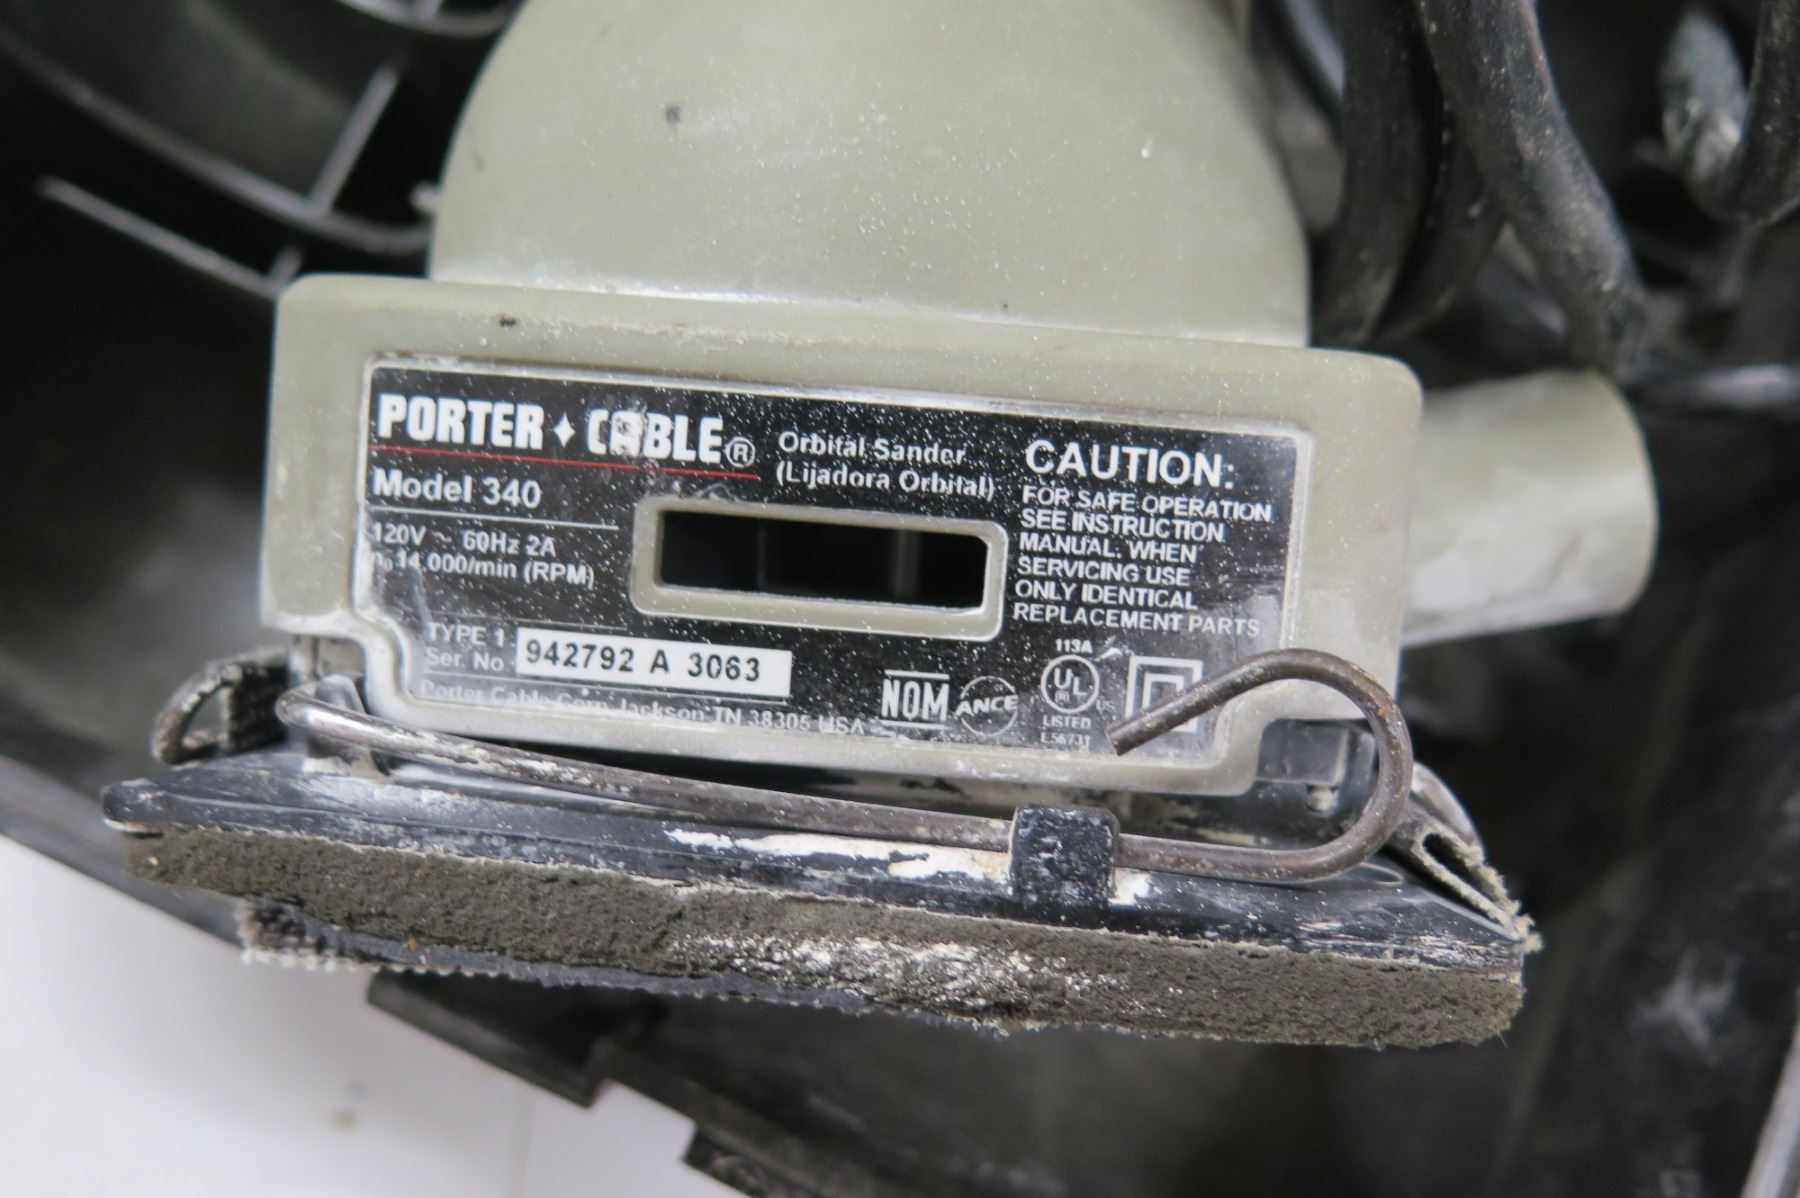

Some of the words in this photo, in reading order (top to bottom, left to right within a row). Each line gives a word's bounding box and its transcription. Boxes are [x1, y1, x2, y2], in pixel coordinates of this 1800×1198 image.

[375, 392, 545, 450] PORTER
[778, 431, 866, 458] Orbital
[873, 438, 966, 465] Sander
[1024, 438, 1235, 490] CAUTION:
[371, 467, 472, 501] Model
[482, 476, 542, 509] 340
[775, 460, 891, 490] (Lijadora
[899, 469, 995, 500] Orbital)
[1022, 484, 1070, 507] FOR
[1077, 490, 1136, 513] SAFE
[1142, 496, 1273, 523] OPERATION
[372, 522, 427, 546] 120V
[462, 529, 520, 555] 60Hz
[526, 535, 557, 558] 2A
[1020, 508, 1067, 531] SEE
[1072, 511, 1225, 543] INSTRUCTION
[1019, 532, 1122, 559] MANUAL.
[1129, 540, 1198, 563] WHEN
[523, 561, 595, 590] (RPM)
[1017, 555, 1140, 583] SERVICING
[1145, 565, 1191, 587] USE
[1014, 579, 1077, 602] ONLY
[1081, 583, 1198, 610] IDENTICAL
[427, 621, 487, 646] TYPE
[1013, 602, 1183, 632] REPLACEMENT
[1189, 616, 1260, 638] PARTS
[525, 638, 634, 674] 942792
[649, 649, 670, 675] A
[687, 652, 762, 683] 3063
[1055, 638, 1093, 654] 113A
[1053, 667, 1088, 697] UL
[881, 679, 949, 722] NOM
[955, 693, 1019, 717] ANCE
[713, 706, 743, 726] TN
[749, 710, 811, 732] 38305
[818, 716, 866, 736] USA
[1042, 715, 1092, 730] LISTED
